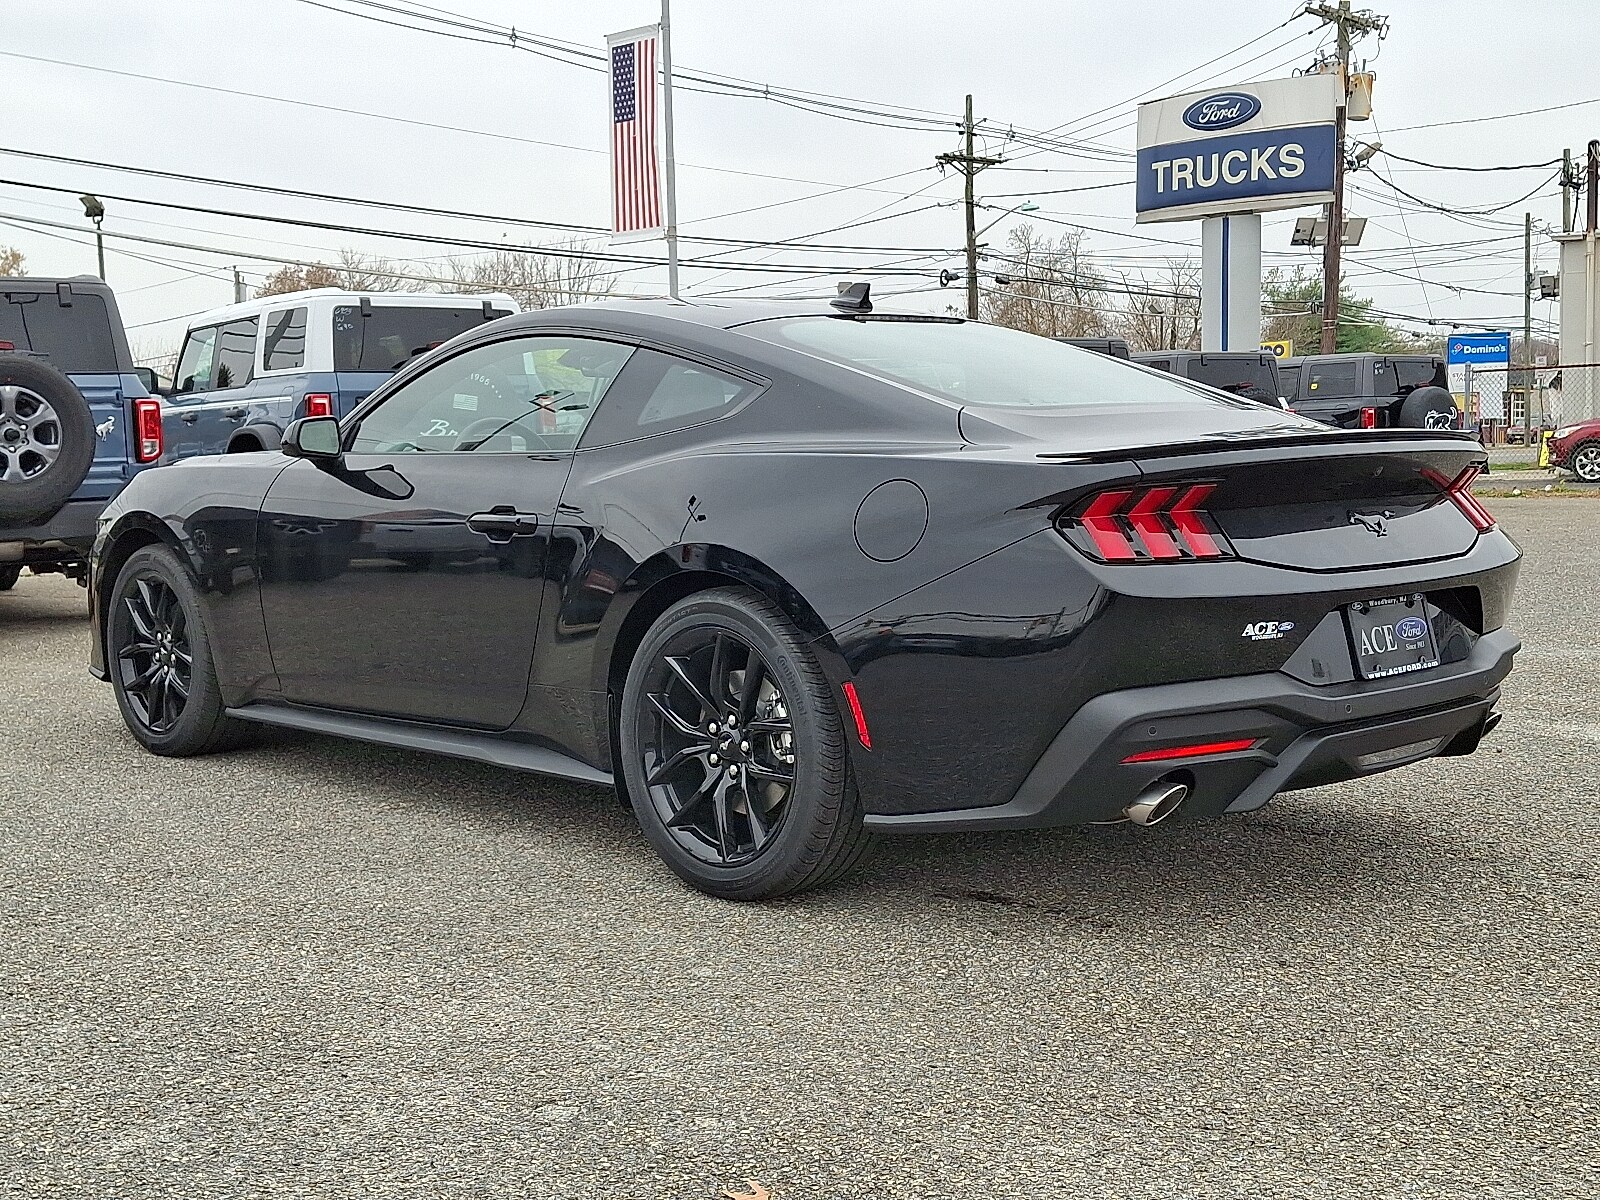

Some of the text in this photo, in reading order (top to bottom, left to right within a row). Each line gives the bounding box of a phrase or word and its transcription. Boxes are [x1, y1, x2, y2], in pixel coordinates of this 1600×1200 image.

[1199, 99, 1241, 124] Ford
[1151, 143, 1306, 194] TRUCKS
[1463, 344, 1507, 355] Domino's
[1241, 621, 1279, 637] ACE
[1361, 621, 1422, 657] ACE Ford
[1367, 660, 1439, 680] www.ACEFORD.com
[777, 655, 808, 716] Continental
